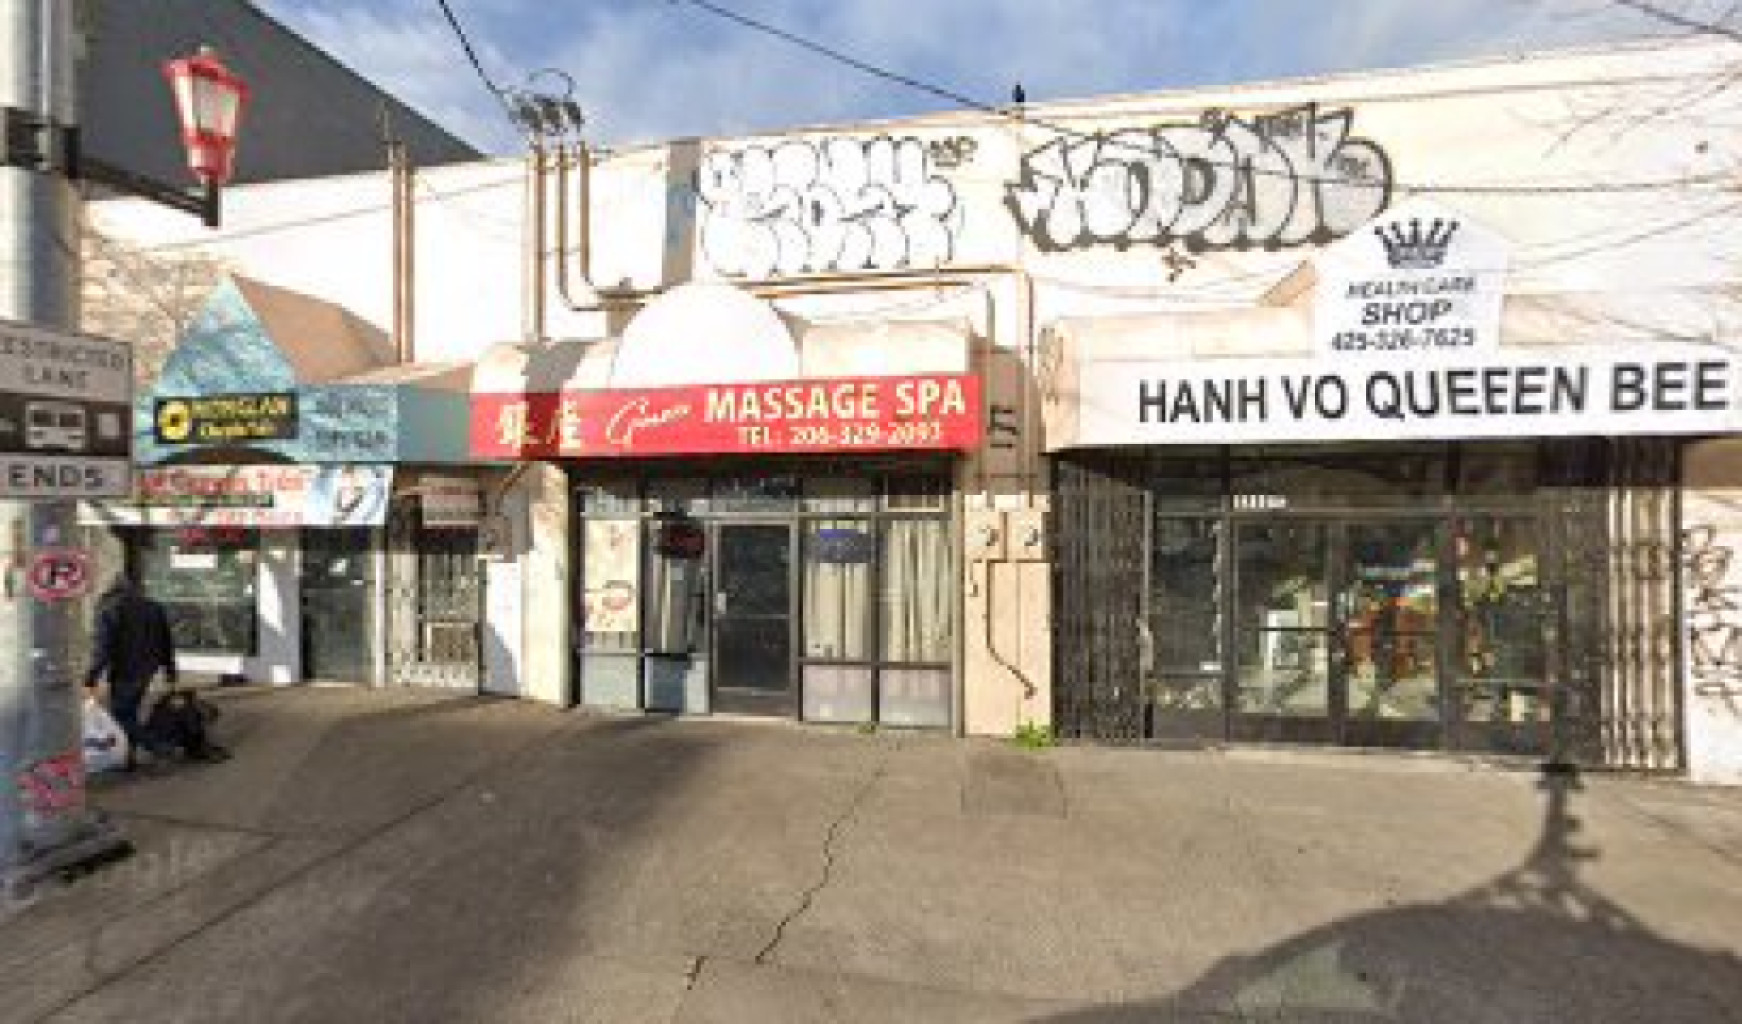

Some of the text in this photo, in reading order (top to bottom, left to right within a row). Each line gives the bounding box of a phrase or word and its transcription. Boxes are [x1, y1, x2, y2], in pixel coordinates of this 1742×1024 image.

[1361, 299, 1452, 326] SHOP
[24, 365, 90, 389] LANE
[704, 383, 881, 423] MASSAGE
[894, 378, 966, 416] SPA
[1138, 360, 1731, 423] HANH VO QUEEEN BEE
[8, 463, 105, 489] ENDS
